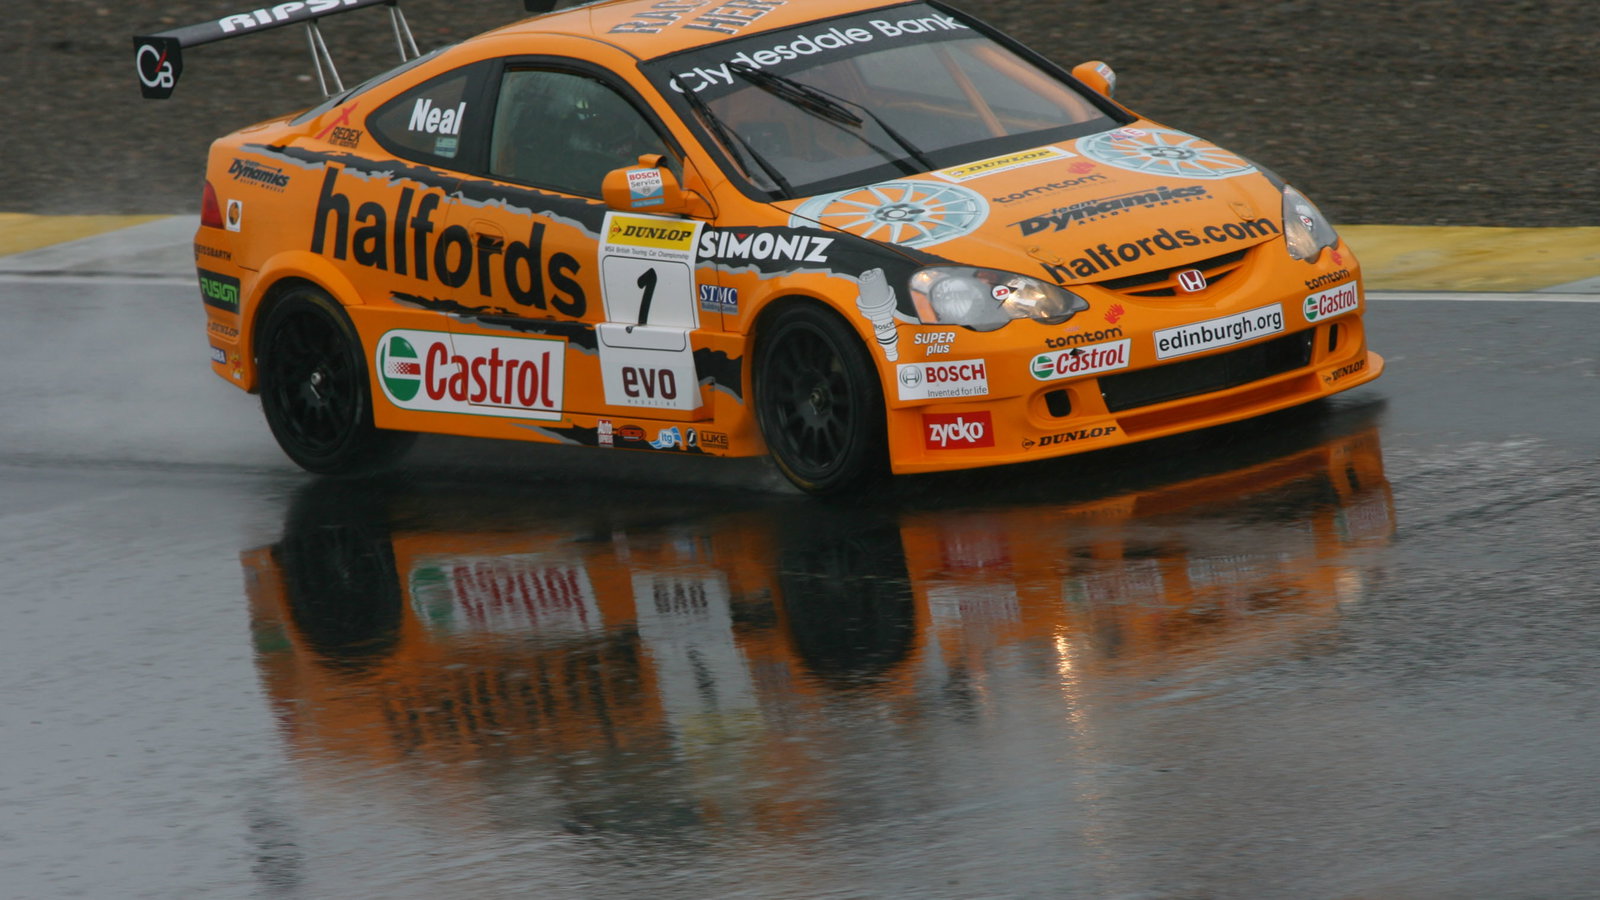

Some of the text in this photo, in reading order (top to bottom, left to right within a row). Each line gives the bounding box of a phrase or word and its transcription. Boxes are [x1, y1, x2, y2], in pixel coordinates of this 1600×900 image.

[219, 0, 358, 32] RIPS
[669, 14, 970, 95] Clydesdale Bank
[408, 98, 467, 135] Neal
[228, 158, 290, 187] Dynamics
[965, 149, 1051, 172] DUNLOP
[629, 172, 659, 181] BOSCH
[631, 179, 661, 188] Service
[992, 173, 1107, 204] tomtom
[1018, 185, 1207, 237] Dynamics
[310, 166, 586, 318] halfords
[623, 225, 692, 241] DUNLOP
[699, 230, 835, 263] SIMONIZ
[1040, 217, 1280, 284] halfords.com
[200, 277, 238, 304] FUSION
[1305, 268, 1350, 290] tomtom
[637, 267, 657, 325] 1
[700, 284, 738, 305] STMC
[1319, 290, 1356, 316] Castrol
[914, 332, 956, 344] SUPER
[1045, 327, 1123, 348] tomtom
[1158, 309, 1282, 352] edinburgh.org
[926, 343, 950, 356] plus
[1055, 343, 1124, 376] Castrol
[425, 341, 554, 408] Castrol
[622, 366, 677, 400] evo
[925, 363, 986, 383] BOSCH
[1331, 359, 1366, 381] DUNLOP
[927, 385, 988, 398] Invented for life
[929, 416, 984, 447] zycko
[1038, 426, 1118, 447] DUNLOP
